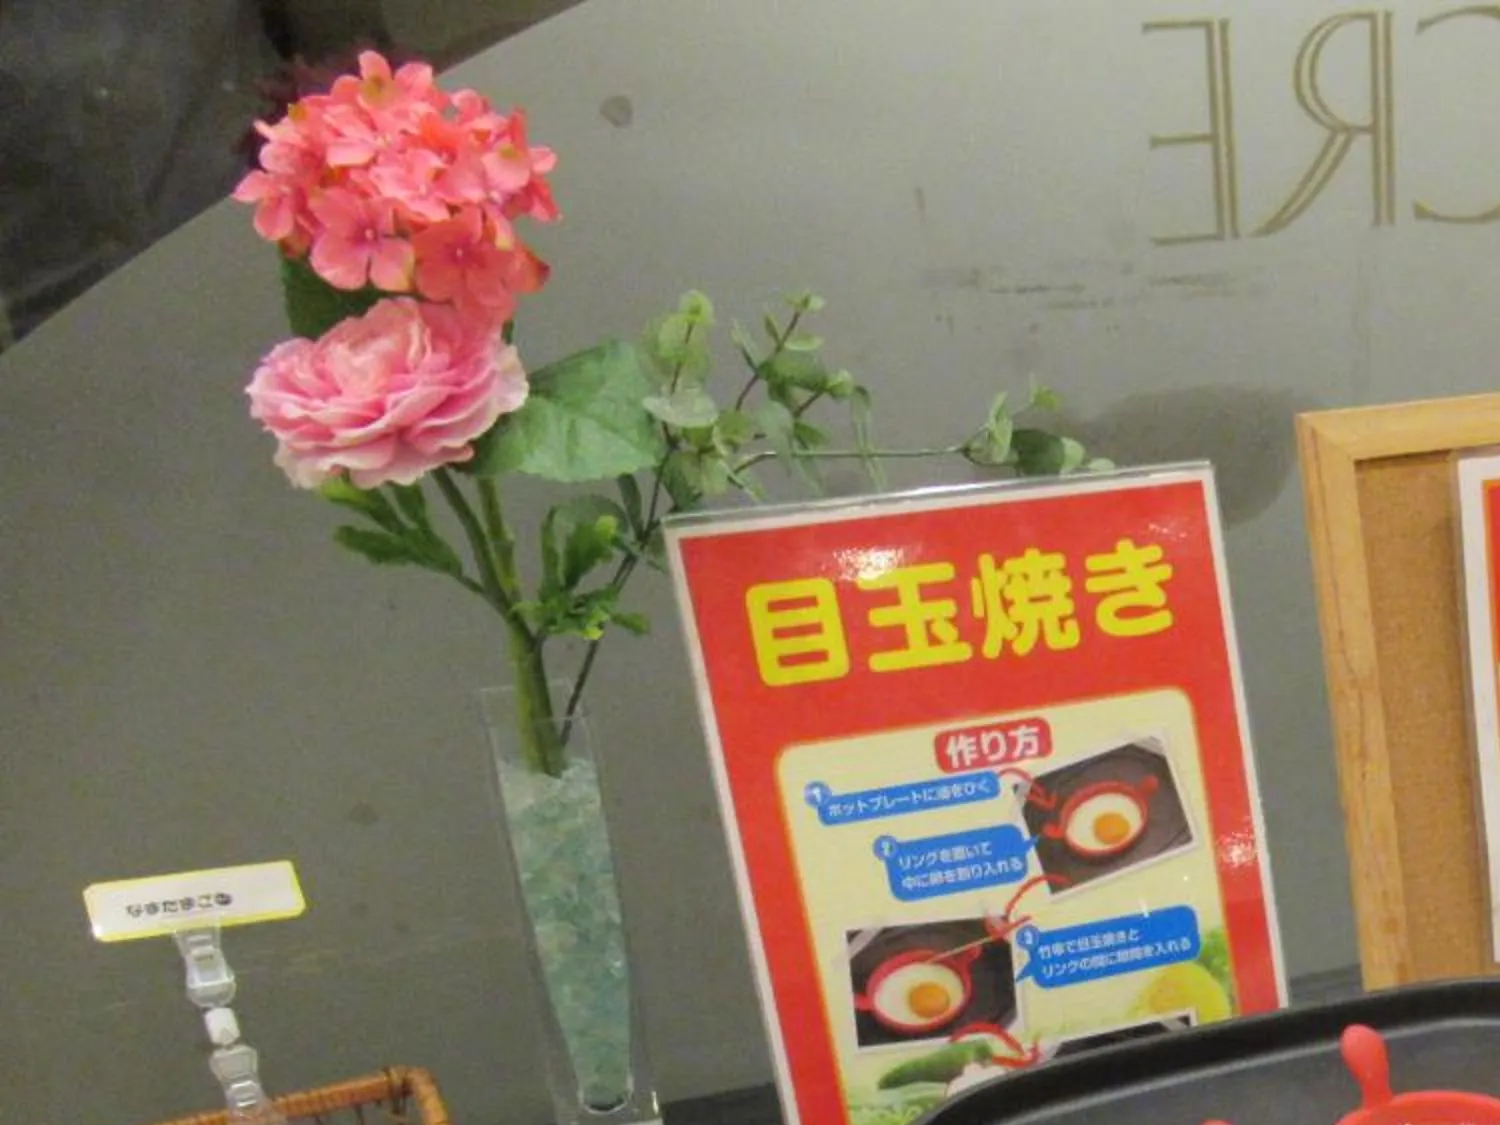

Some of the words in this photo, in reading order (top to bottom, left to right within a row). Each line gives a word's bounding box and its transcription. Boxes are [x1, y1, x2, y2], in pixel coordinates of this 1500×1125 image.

[745, 539, 1174, 688] 目玉焼き
[945, 724, 1041, 768] 作り方
